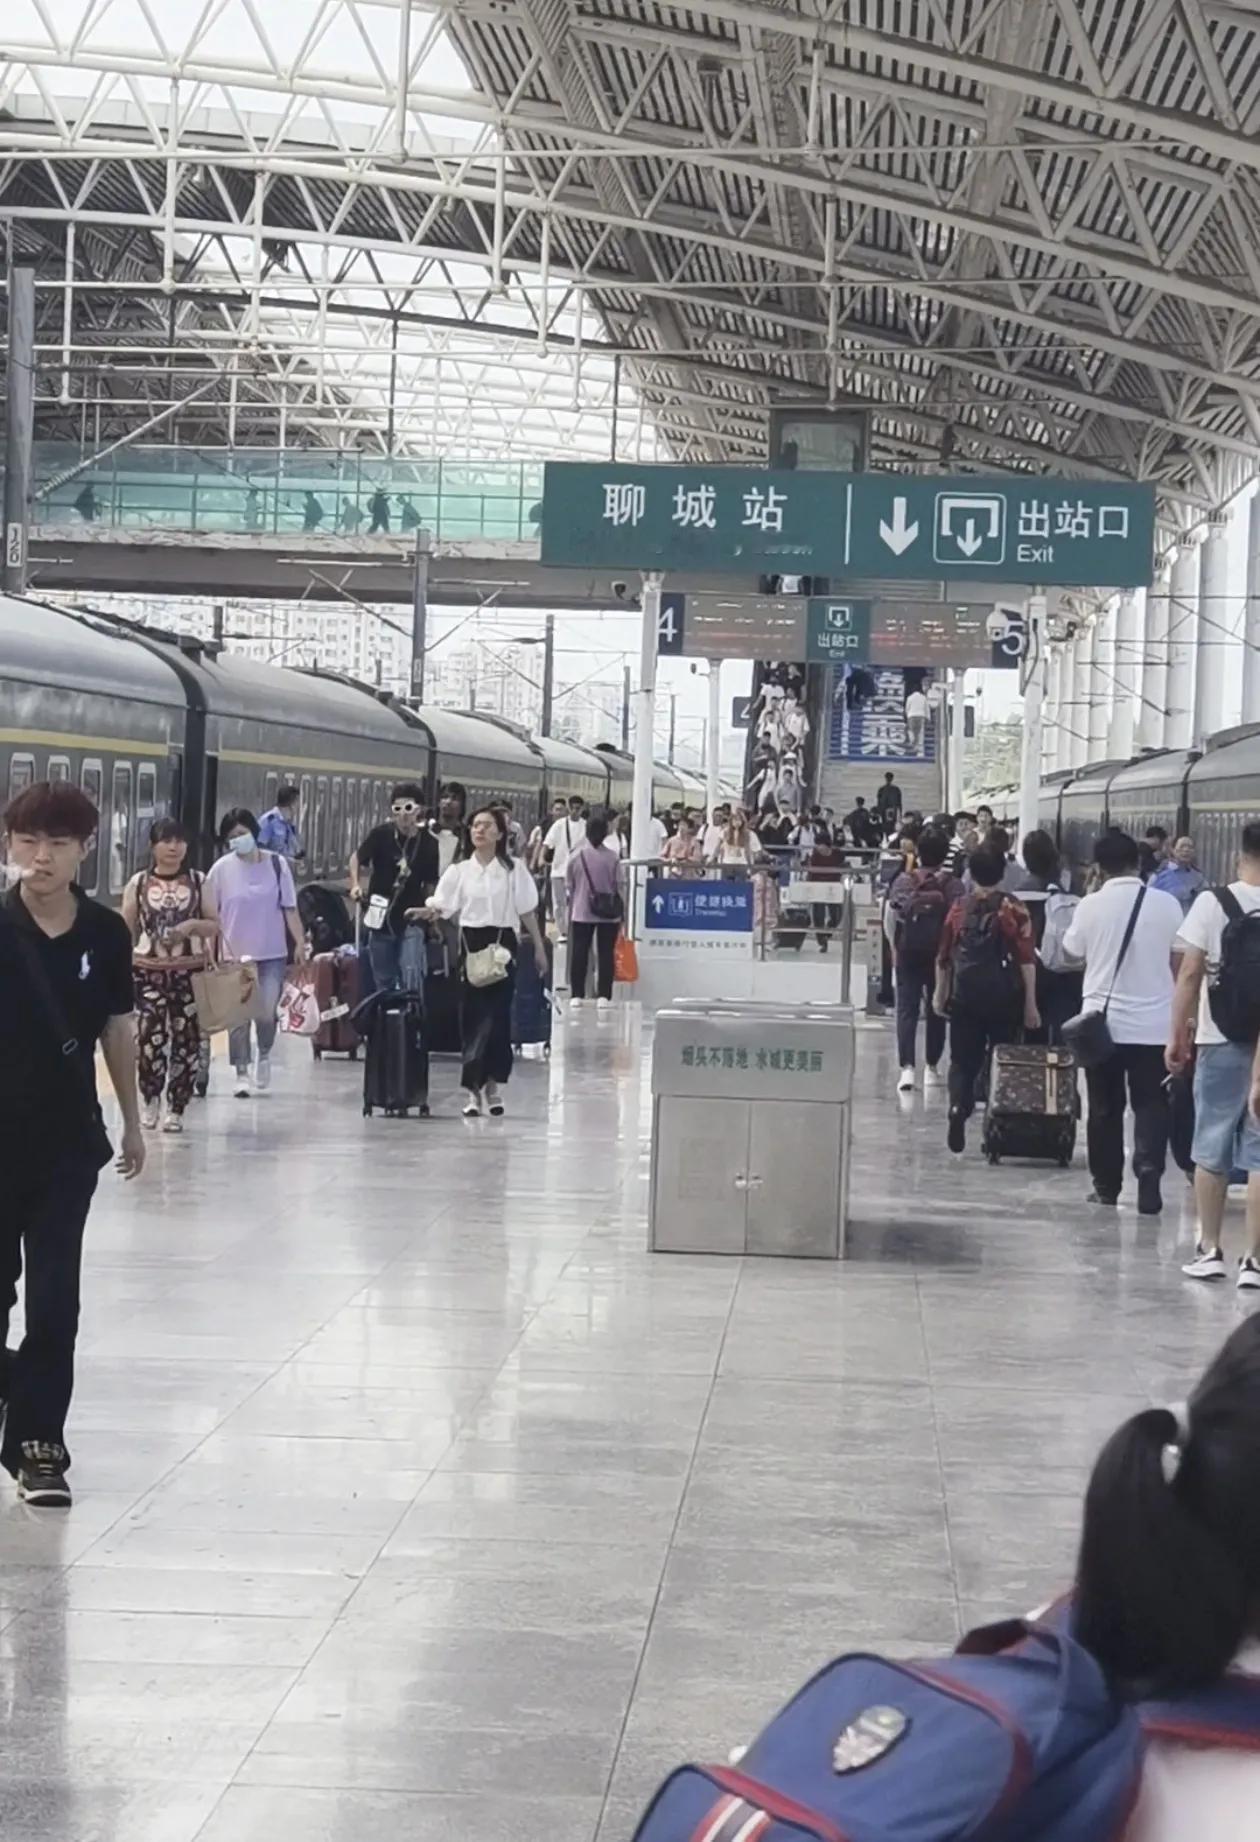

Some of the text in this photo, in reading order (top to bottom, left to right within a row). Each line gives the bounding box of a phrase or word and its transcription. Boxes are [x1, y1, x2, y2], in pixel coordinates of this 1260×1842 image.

[602, 483, 788, 532] 聊城站
[1018, 500, 1129, 538] 出站口
[1017, 544, 1054, 562] Exit
[659, 607, 678, 643] 4
[817, 632, 859, 648] 出站口
[1001, 620, 1027, 655] 5
